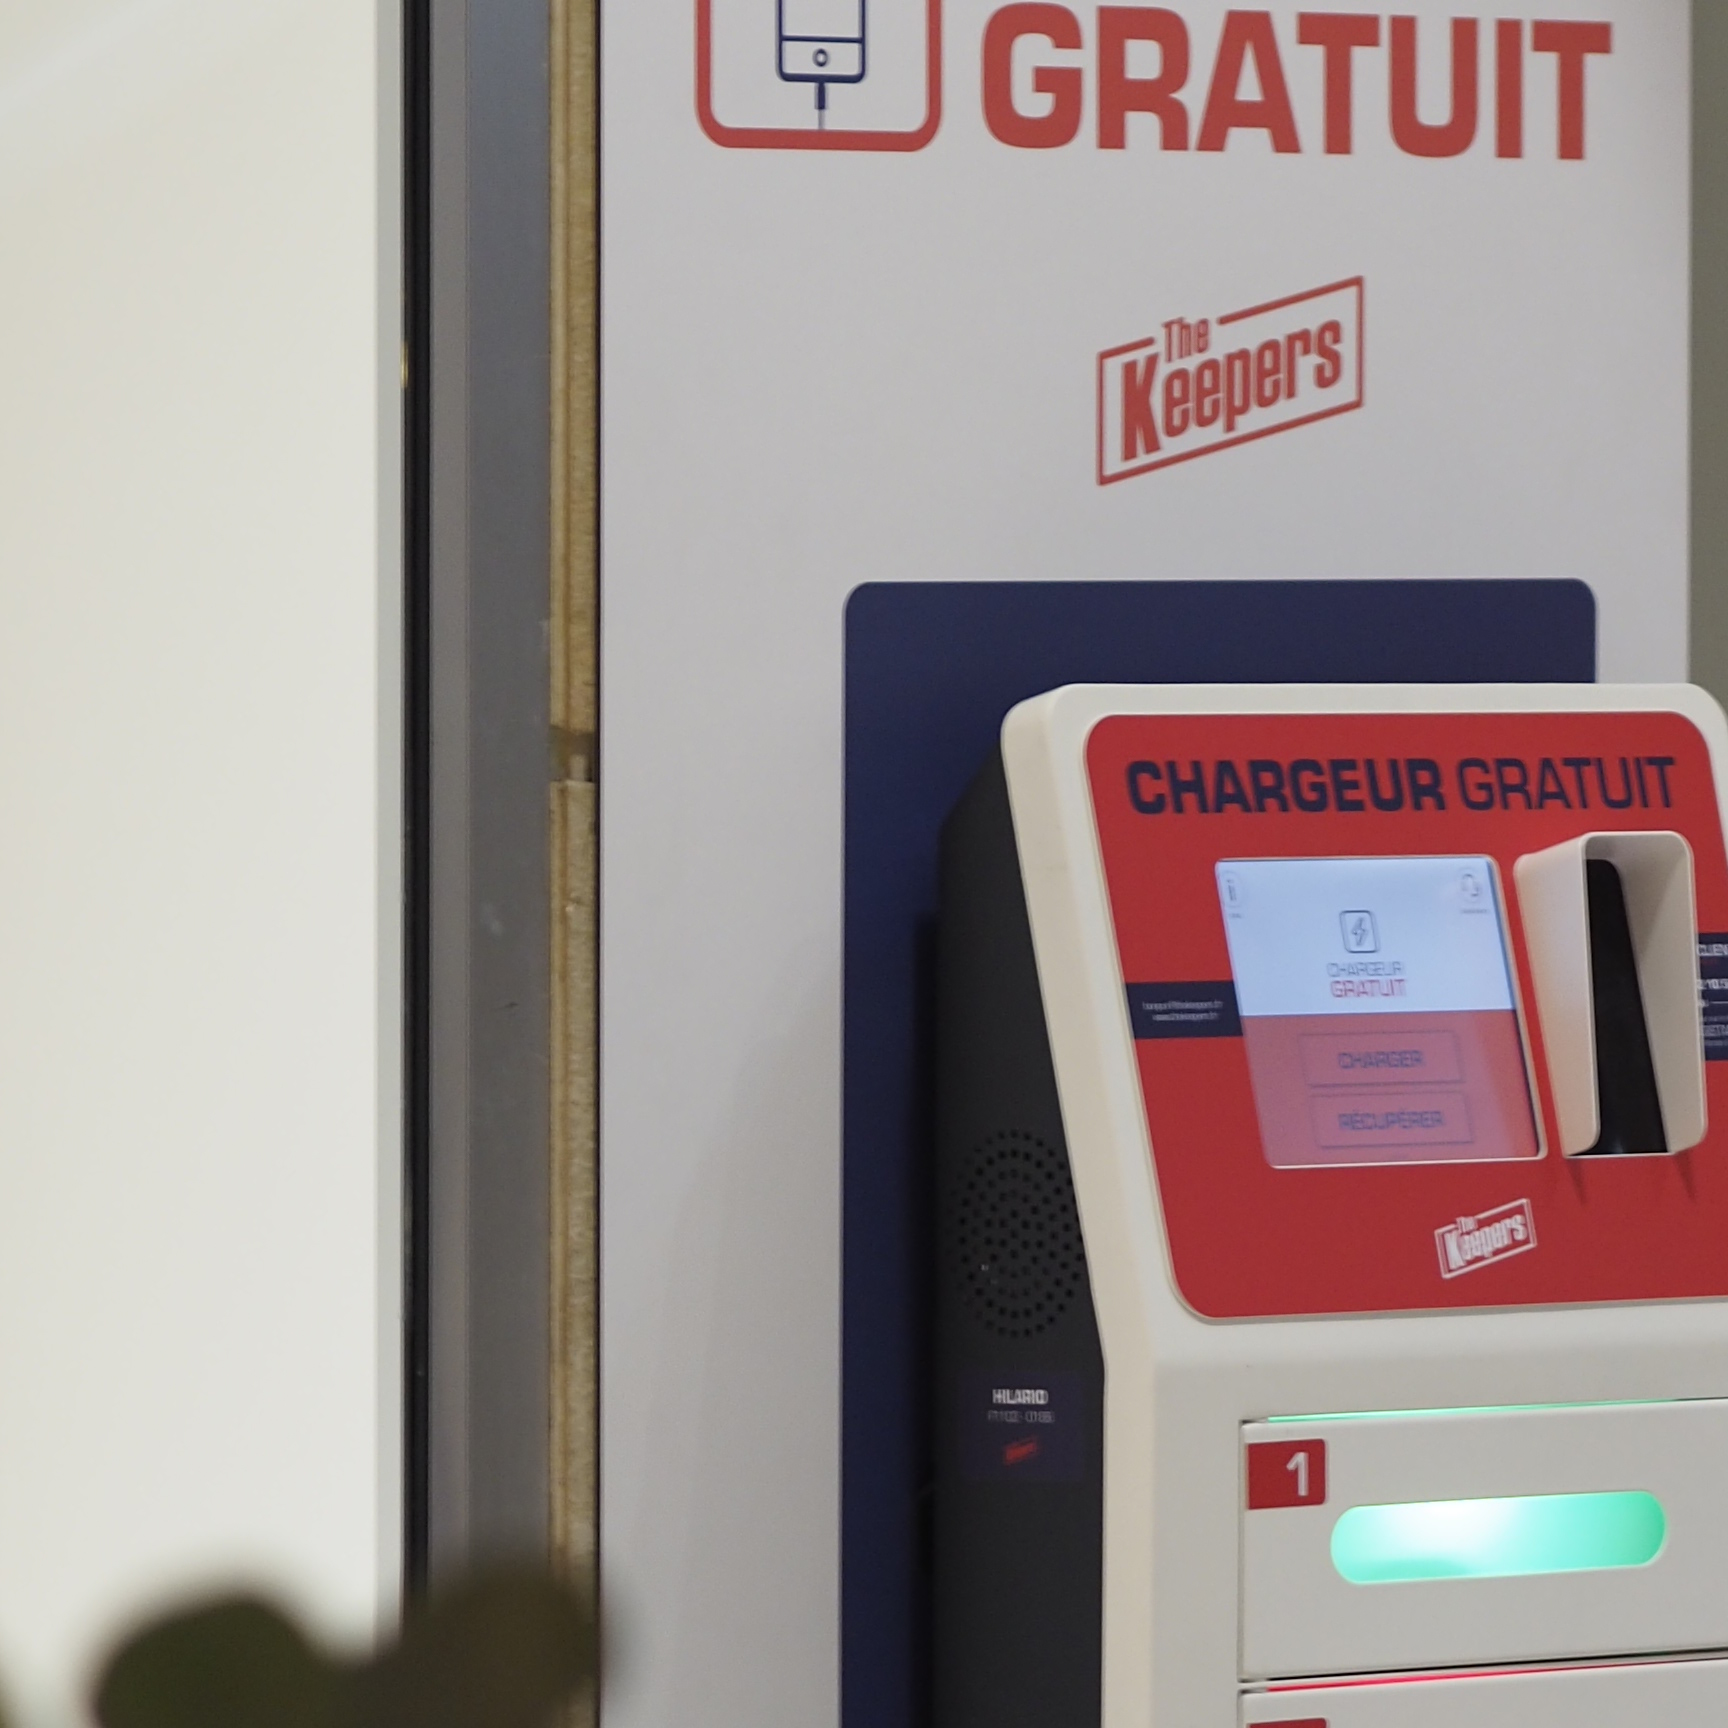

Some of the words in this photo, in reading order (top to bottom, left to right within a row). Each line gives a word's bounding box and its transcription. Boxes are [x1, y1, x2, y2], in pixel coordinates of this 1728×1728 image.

[980, 1, 1613, 160] GRATUIT
[1162, 317, 1210, 363] The
[1121, 319, 1342, 462] Keepers
[1126, 758, 1446, 814] CHARGEUR
[1456, 756, 1676, 810] GRATUIT
[1329, 978, 1406, 998] GRATUIT
[1338, 1050, 1424, 1069] CHARGER
[1443, 1214, 1528, 1270] Keepers
[992, 1388, 1049, 1405] HILARIO
[1285, 1451, 1310, 1497] 1
